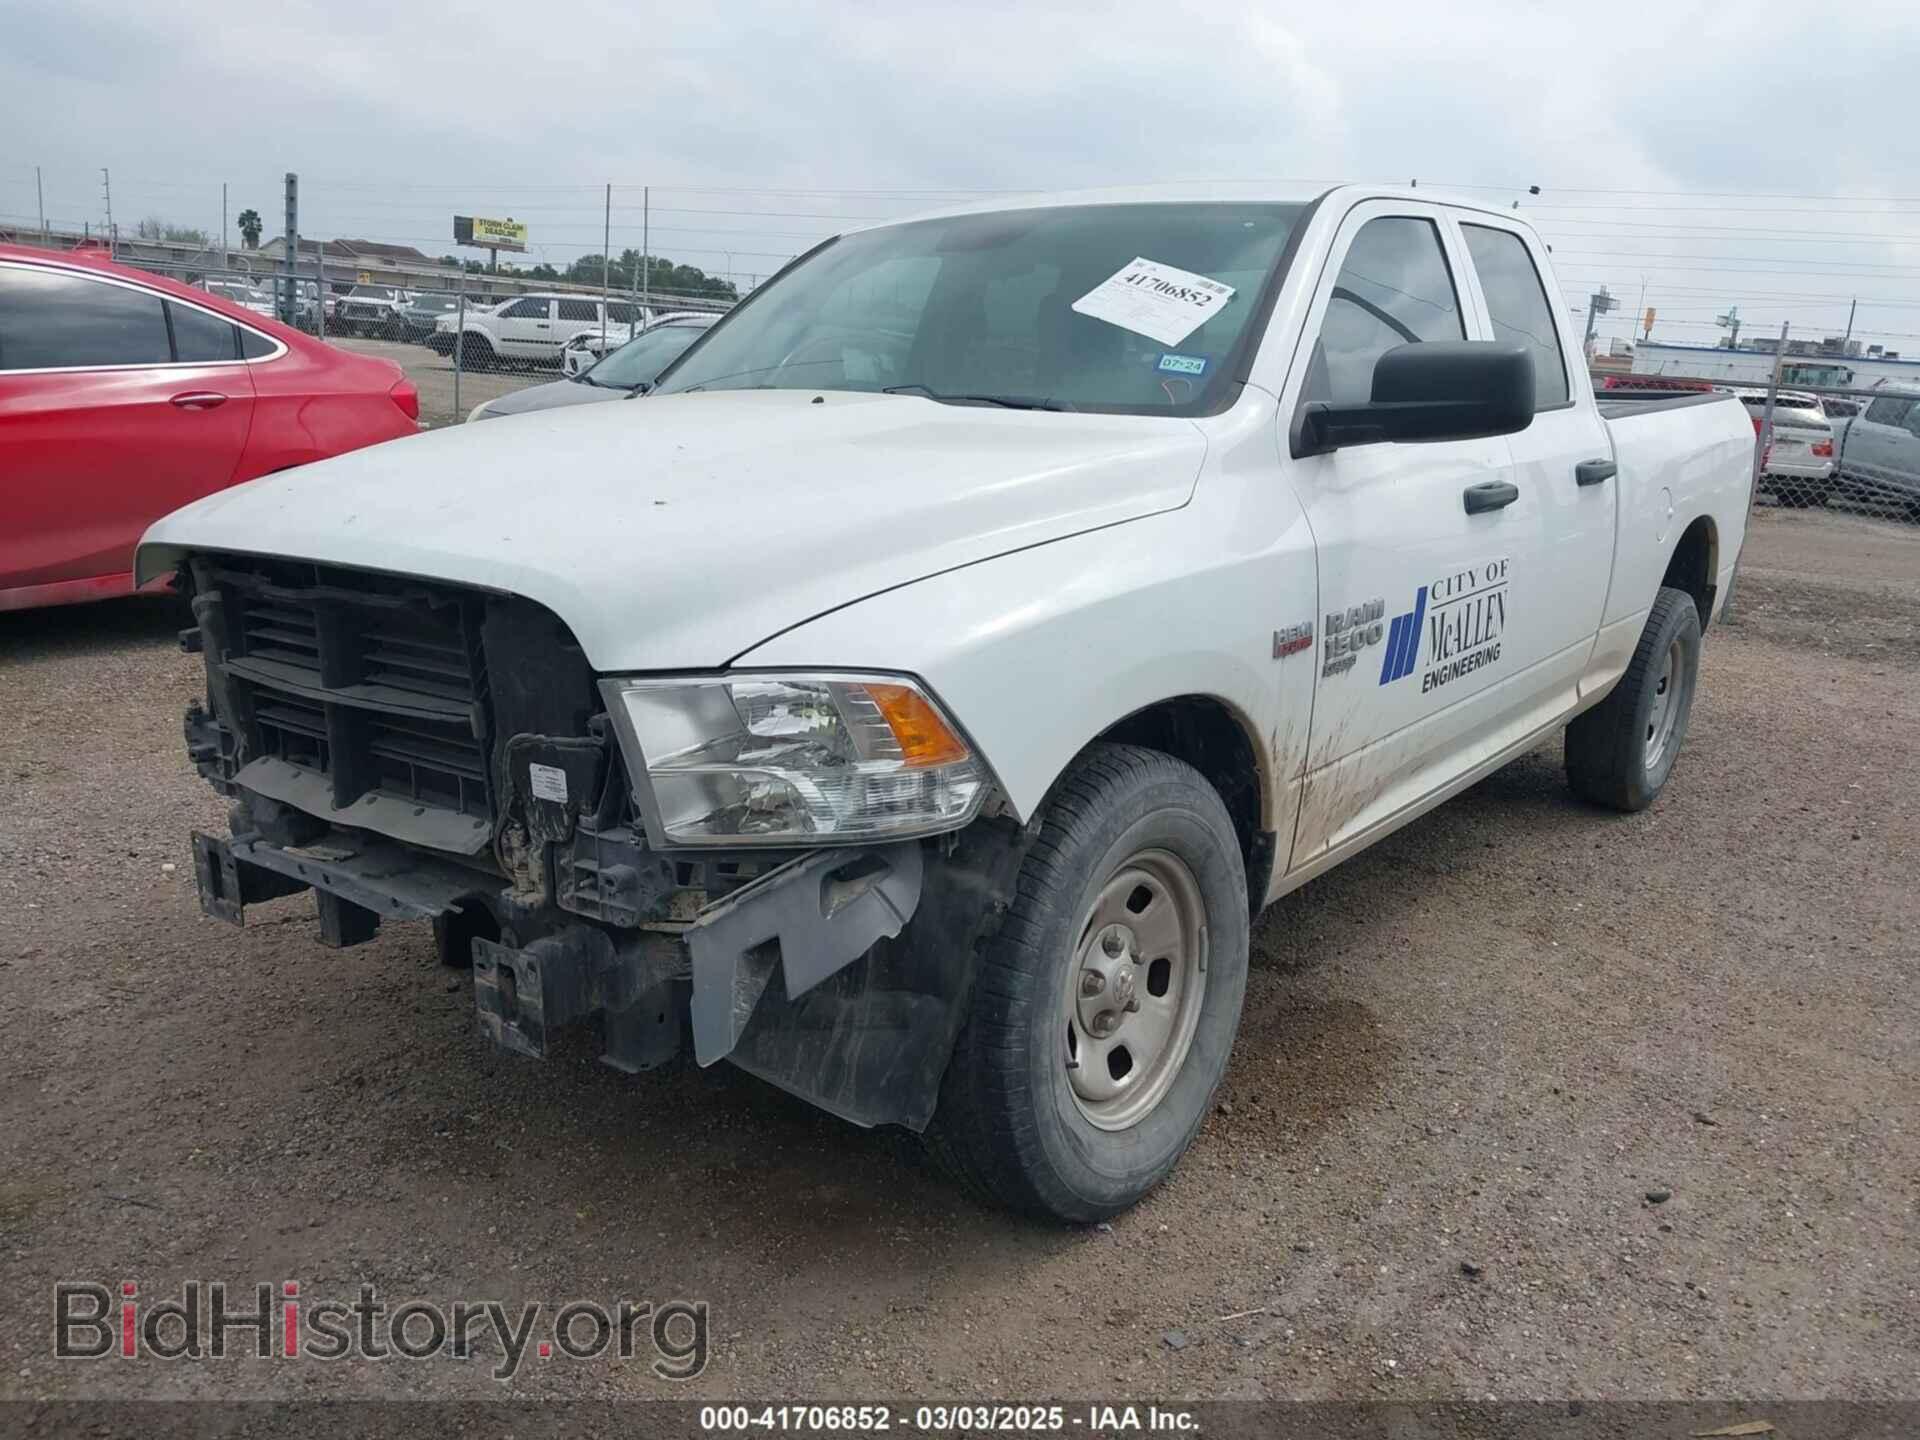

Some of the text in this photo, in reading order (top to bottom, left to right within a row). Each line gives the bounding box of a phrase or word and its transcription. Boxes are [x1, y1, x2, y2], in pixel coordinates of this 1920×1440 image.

[1124, 272, 1212, 307] 41706852
[1431, 558, 1509, 601] CITY OF
[1324, 622, 1384, 664] 1500
[1421, 642, 1501, 694] ENGINEERING
